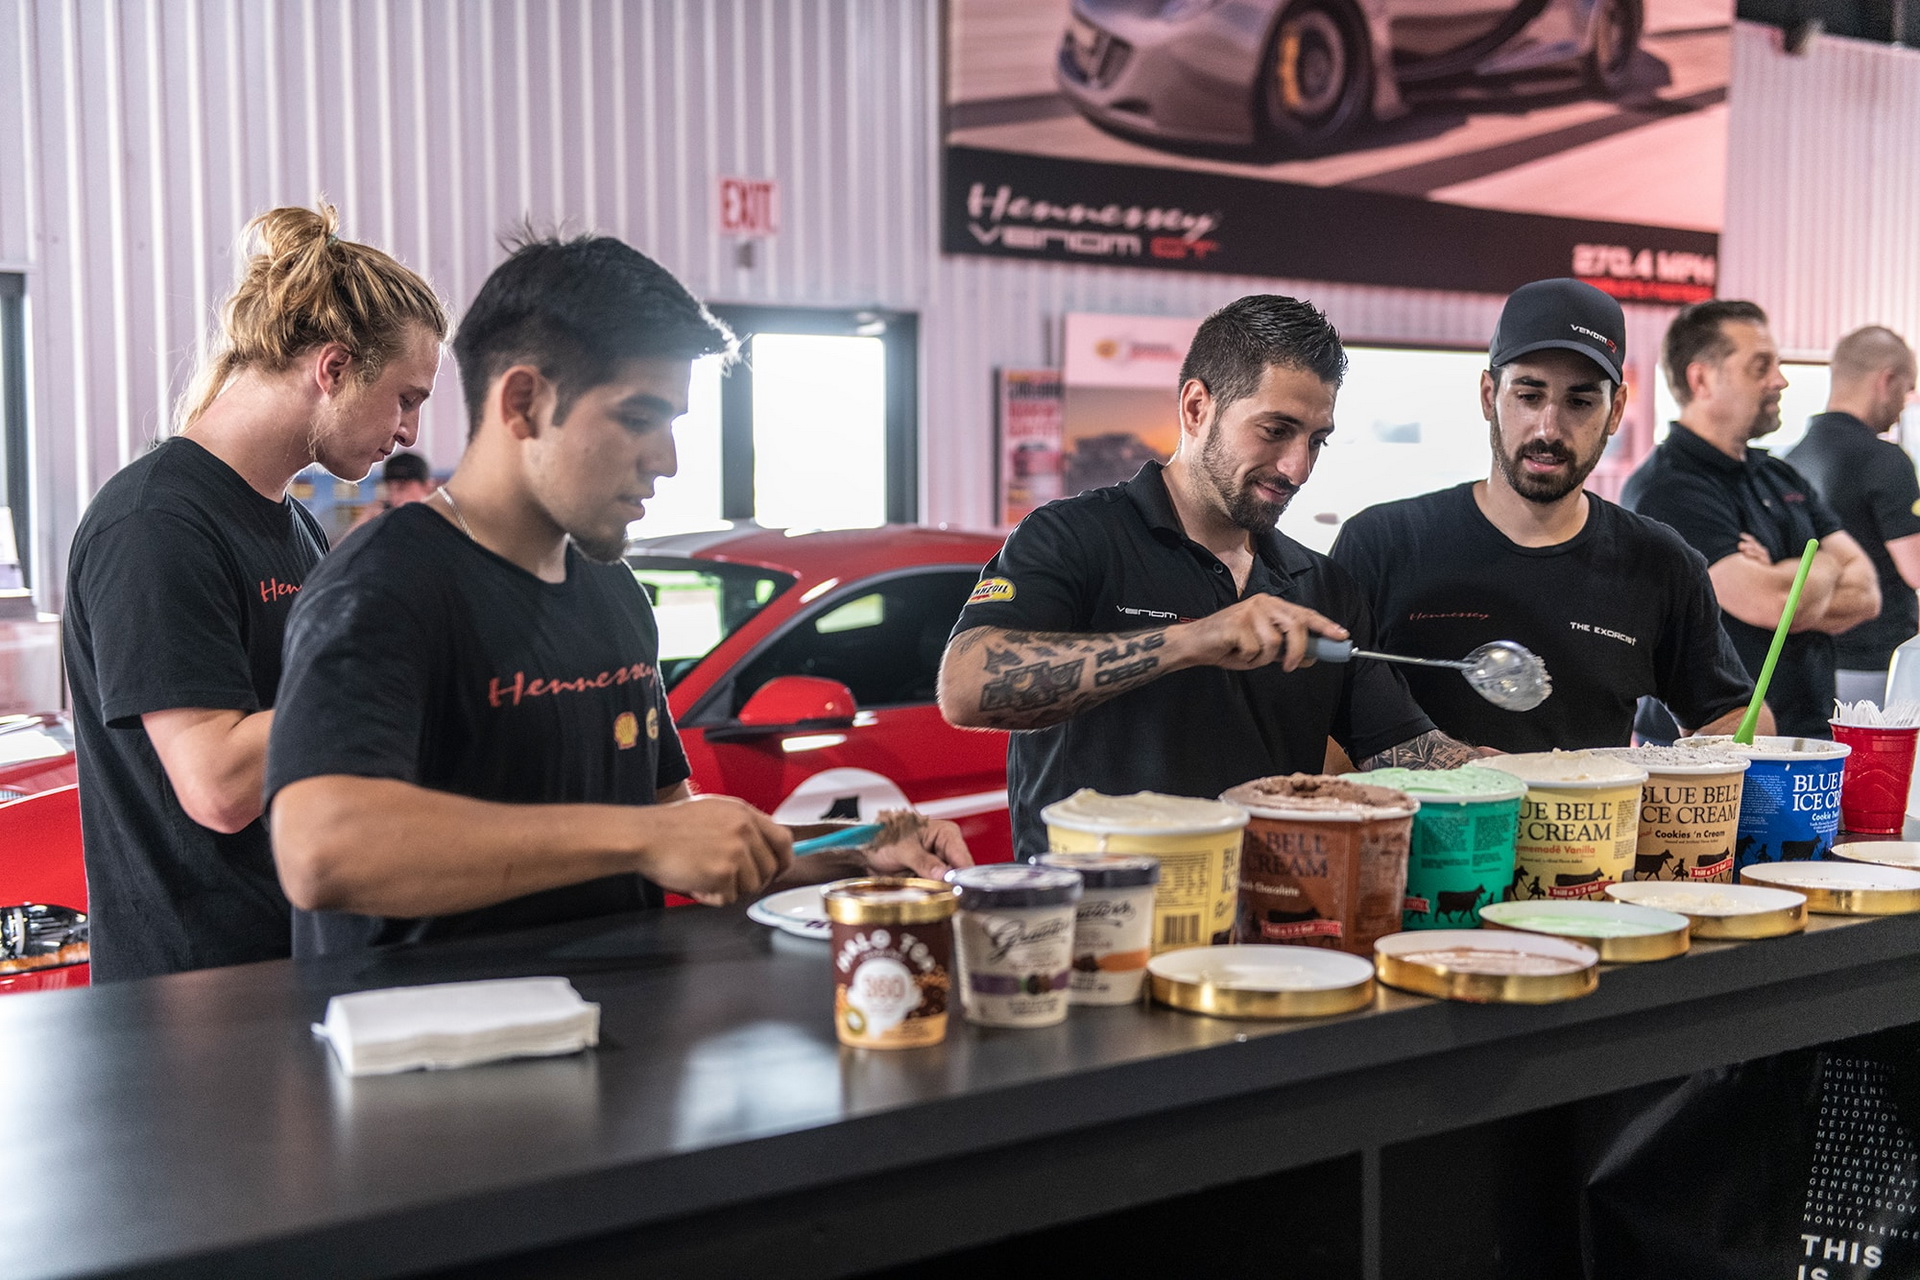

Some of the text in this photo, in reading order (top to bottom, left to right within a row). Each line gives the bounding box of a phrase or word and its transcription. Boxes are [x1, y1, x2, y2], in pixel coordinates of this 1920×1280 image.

[722, 180, 771, 231] EXIT
[1570, 621, 1590, 632] THE
[1793, 772, 1839, 792] BLUE
[1641, 784, 1738, 804] BLUE BELL
[1792, 793, 1823, 811] ICE
[1519, 801, 1613, 820] UE BELL
[1641, 803, 1737, 824] CE CREAM
[1528, 822, 1611, 841] CREAM
[1655, 829, 1691, 838] Cookies
[1703, 829, 1726, 838] Cream
[1564, 845, 1596, 854] Vanilla
[1825, 1058, 1895, 1073] ACCEPT
[1819, 1119, 1886, 1133] LETTING
[1815, 1142, 1918, 1161] SELF-DISCIP
[1813, 1154, 1902, 1172] INTENTION
[1811, 1165, 1918, 1189] CONCENTRAT
[1809, 1177, 1912, 1200] GENEROSITY
[1805, 1201, 1864, 1217] PURITY
[1807, 1189, 1918, 1214] SELF-DISCOV
[1803, 1213, 1920, 1240] NONVIOLENCE
[1801, 1234, 1882, 1269] THIS
